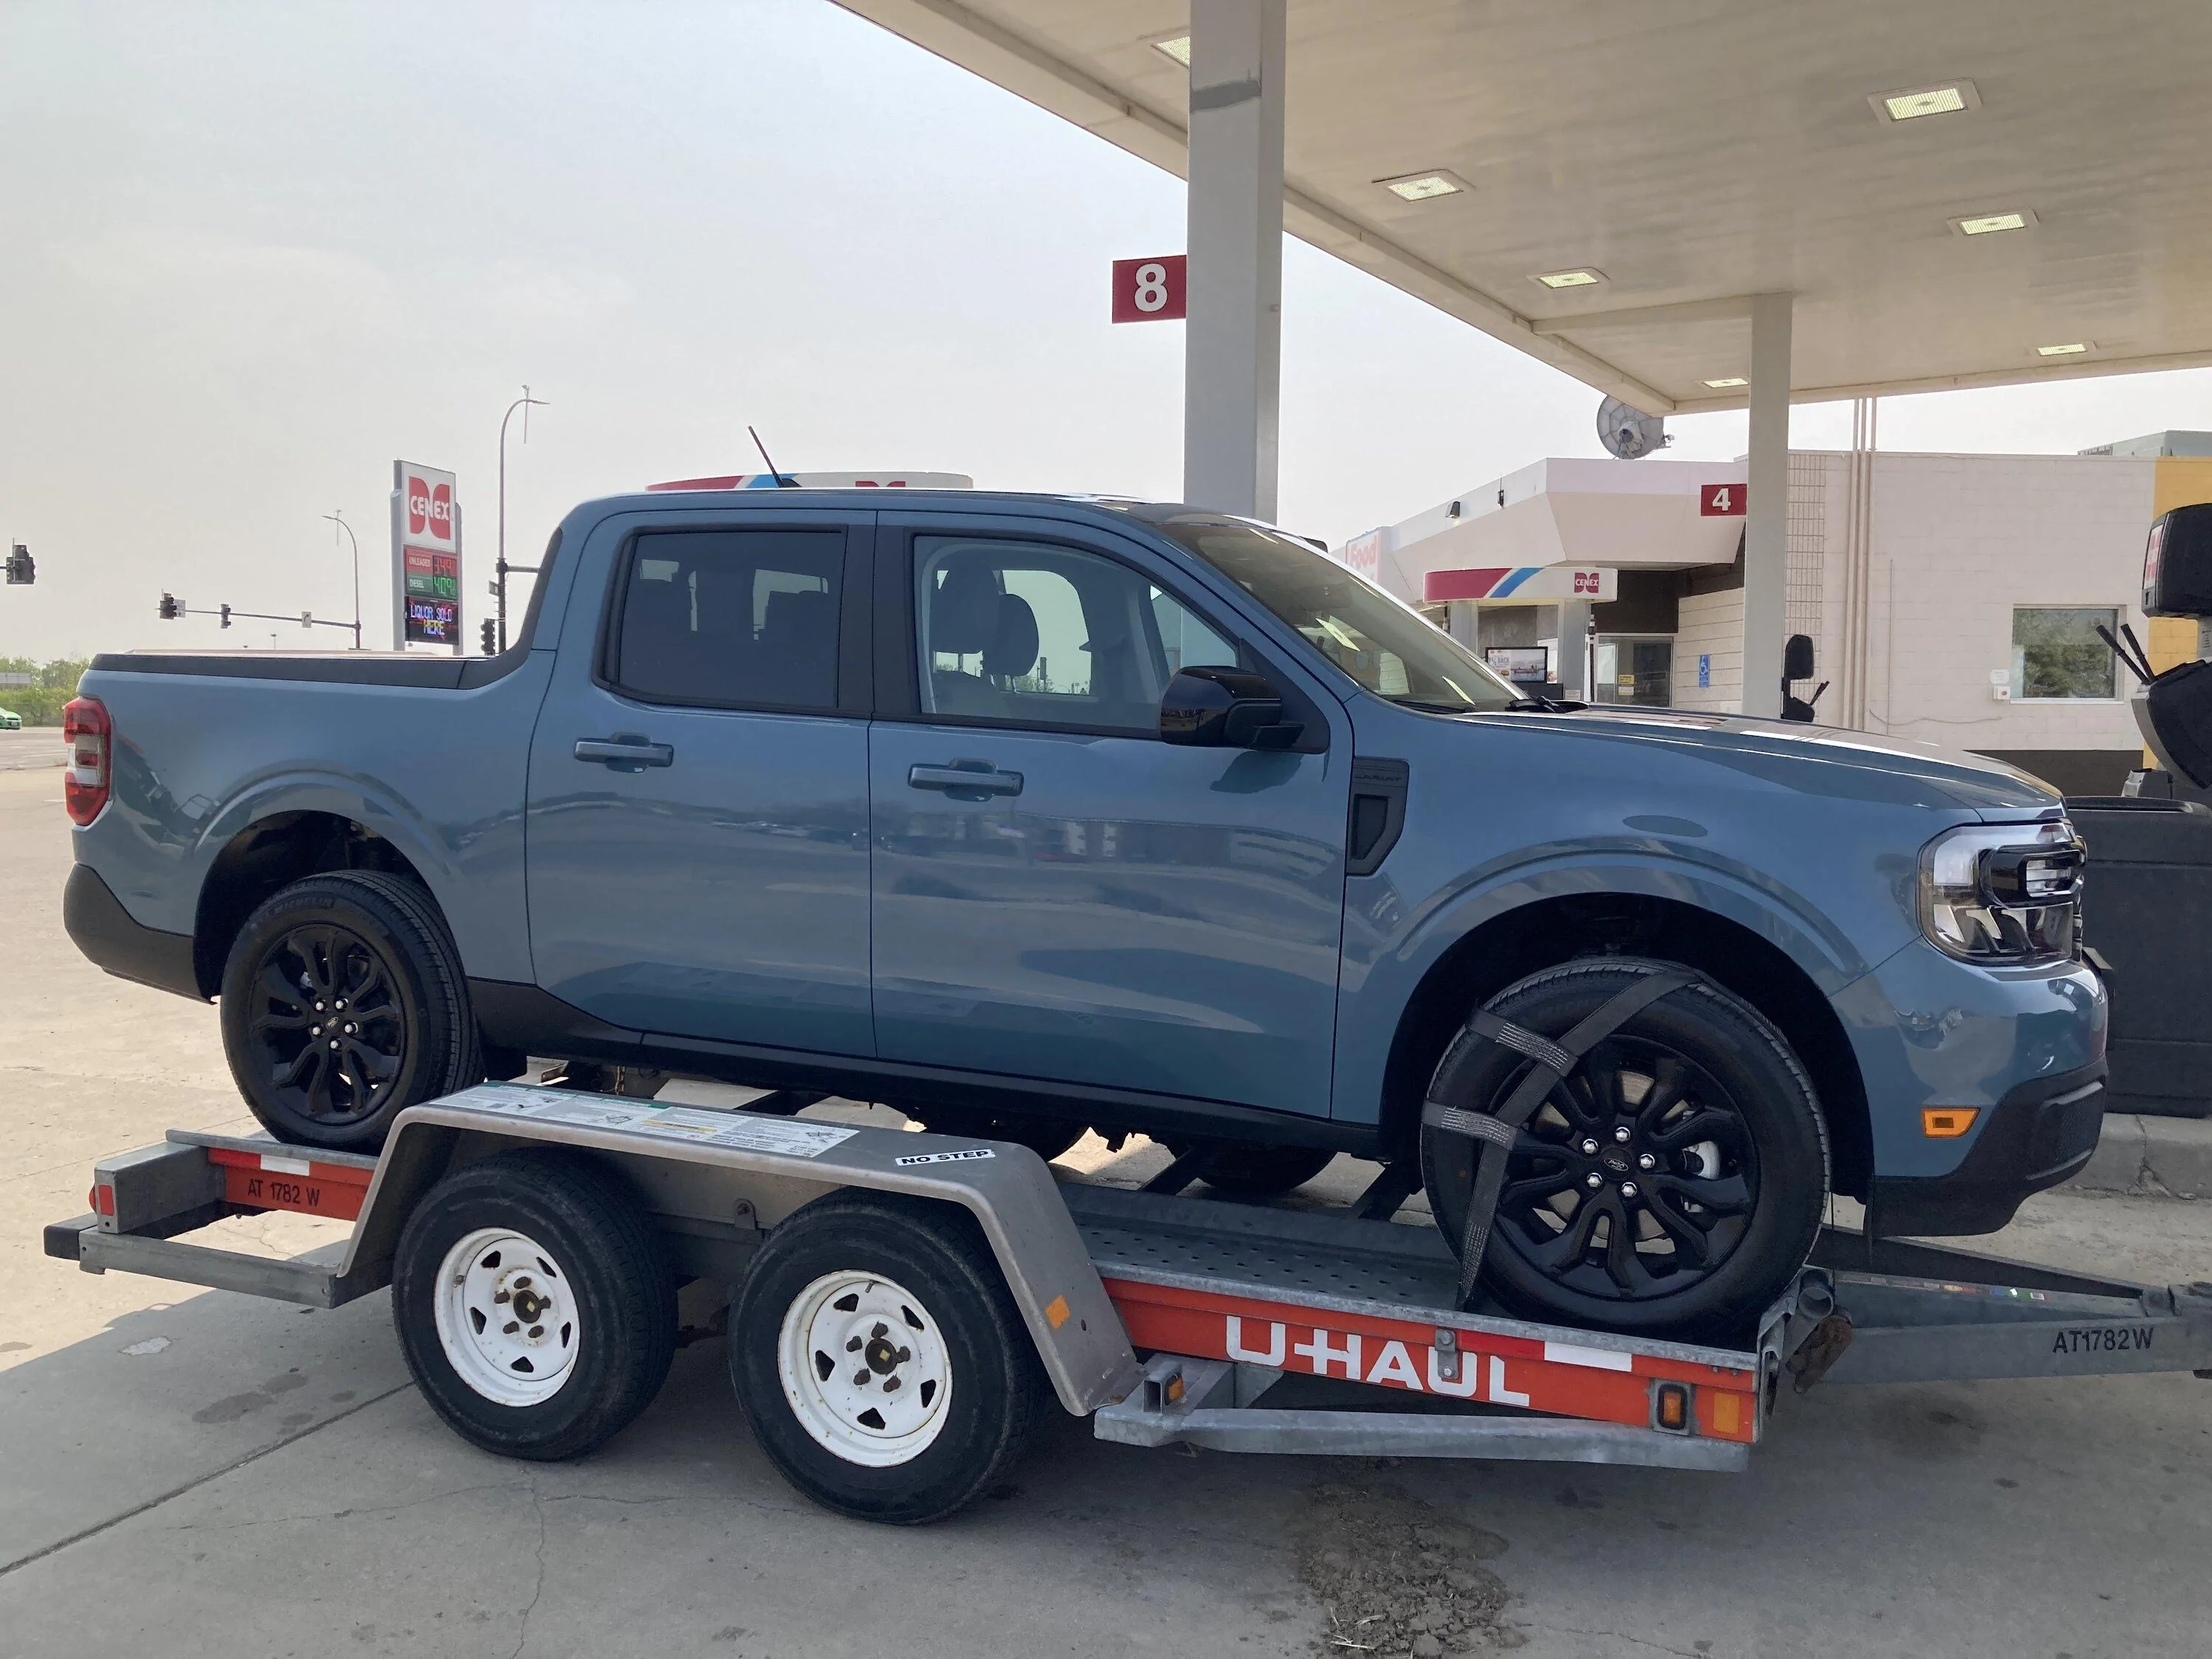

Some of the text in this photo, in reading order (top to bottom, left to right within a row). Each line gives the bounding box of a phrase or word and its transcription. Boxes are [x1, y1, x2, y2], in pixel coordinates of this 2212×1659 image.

[1134, 263, 1168, 312] 8
[410, 495, 450, 521] CENEX
[1712, 487, 1731, 511] 4
[408, 556, 431, 567] UNLEADED
[1349, 536, 1377, 570] Food
[409, 579, 425, 588] DIESEL
[1575, 579, 1599, 587] CENEX
[410, 604, 453, 622] LIQUOR SOLD
[423, 620, 445, 635] HERE
[1356, 773, 1402, 782] LARIAT
[937, 1150, 989, 1161] STEP
[248, 1178, 320, 1206] AT 1782 W
[2052, 1327, 2154, 1354] AT1782W
[1225, 1315, 1530, 1407] U-HAUL
